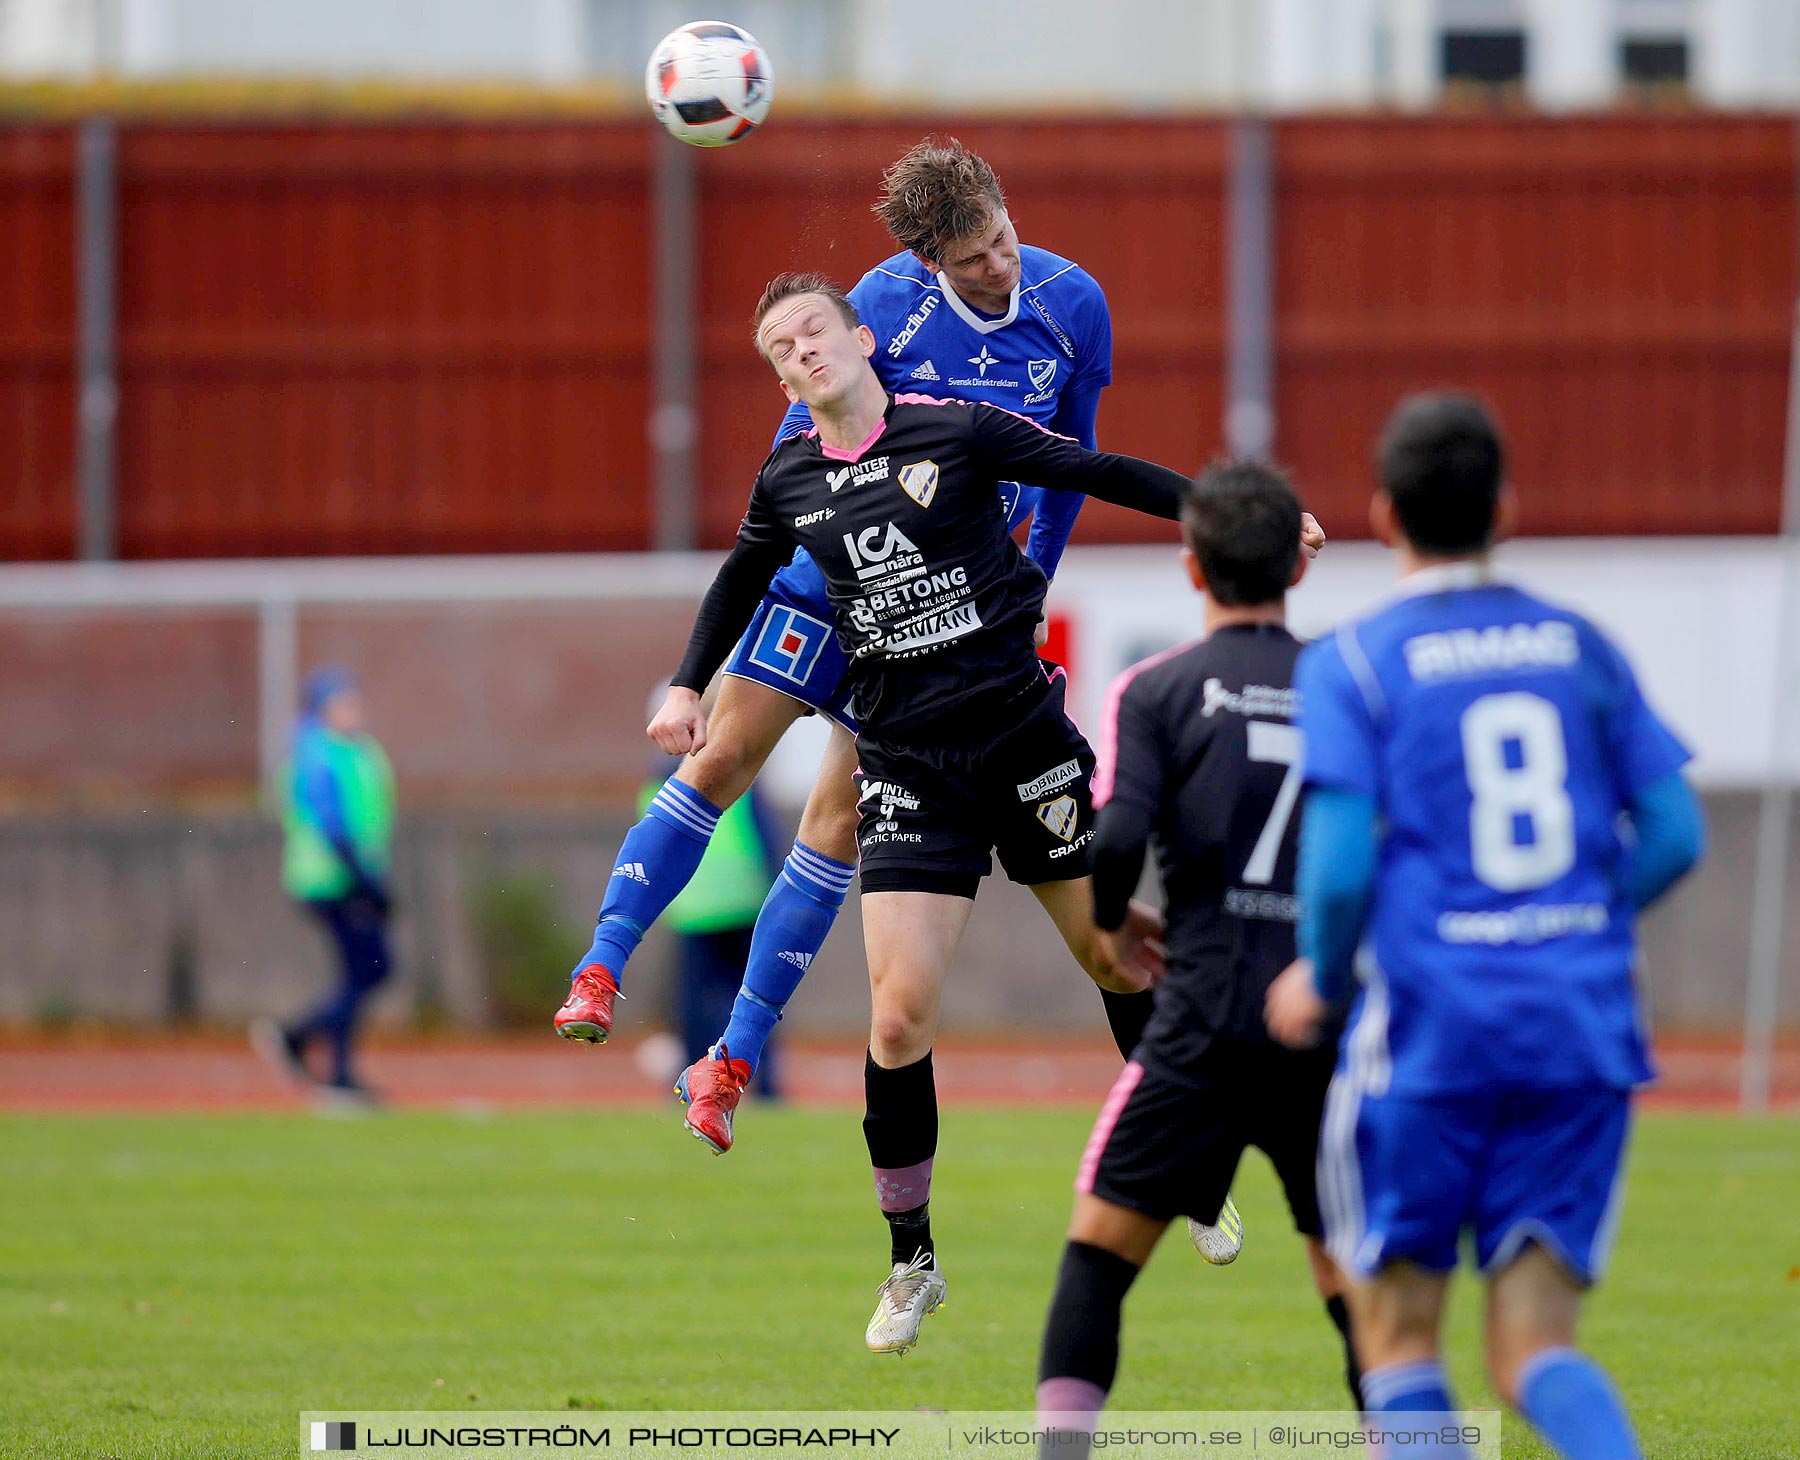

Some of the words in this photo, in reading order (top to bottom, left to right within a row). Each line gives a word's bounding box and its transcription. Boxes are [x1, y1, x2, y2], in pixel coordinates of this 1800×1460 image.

[887, 295, 940, 358] stadium
[910, 371, 941, 381] adidas
[849, 456, 890, 477] INTER
[853, 467, 890, 487] SPORT
[794, 509, 825, 528] CRAFT
[843, 521, 919, 568] ICA
[886, 552, 924, 571] nära
[869, 566, 968, 612] BETONG
[877, 605, 906, 622] BETONG
[909, 603, 915, 611] &
[1021, 762, 1077, 798] JOBMAN
[1459, 689, 1576, 894] 8
[881, 793, 921, 811] SPORT
[1242, 720, 1303, 885] 7
[891, 833, 922, 843] PAPER
[1048, 834, 1086, 859] CRAFT
[611, 870, 651, 887] adidas
